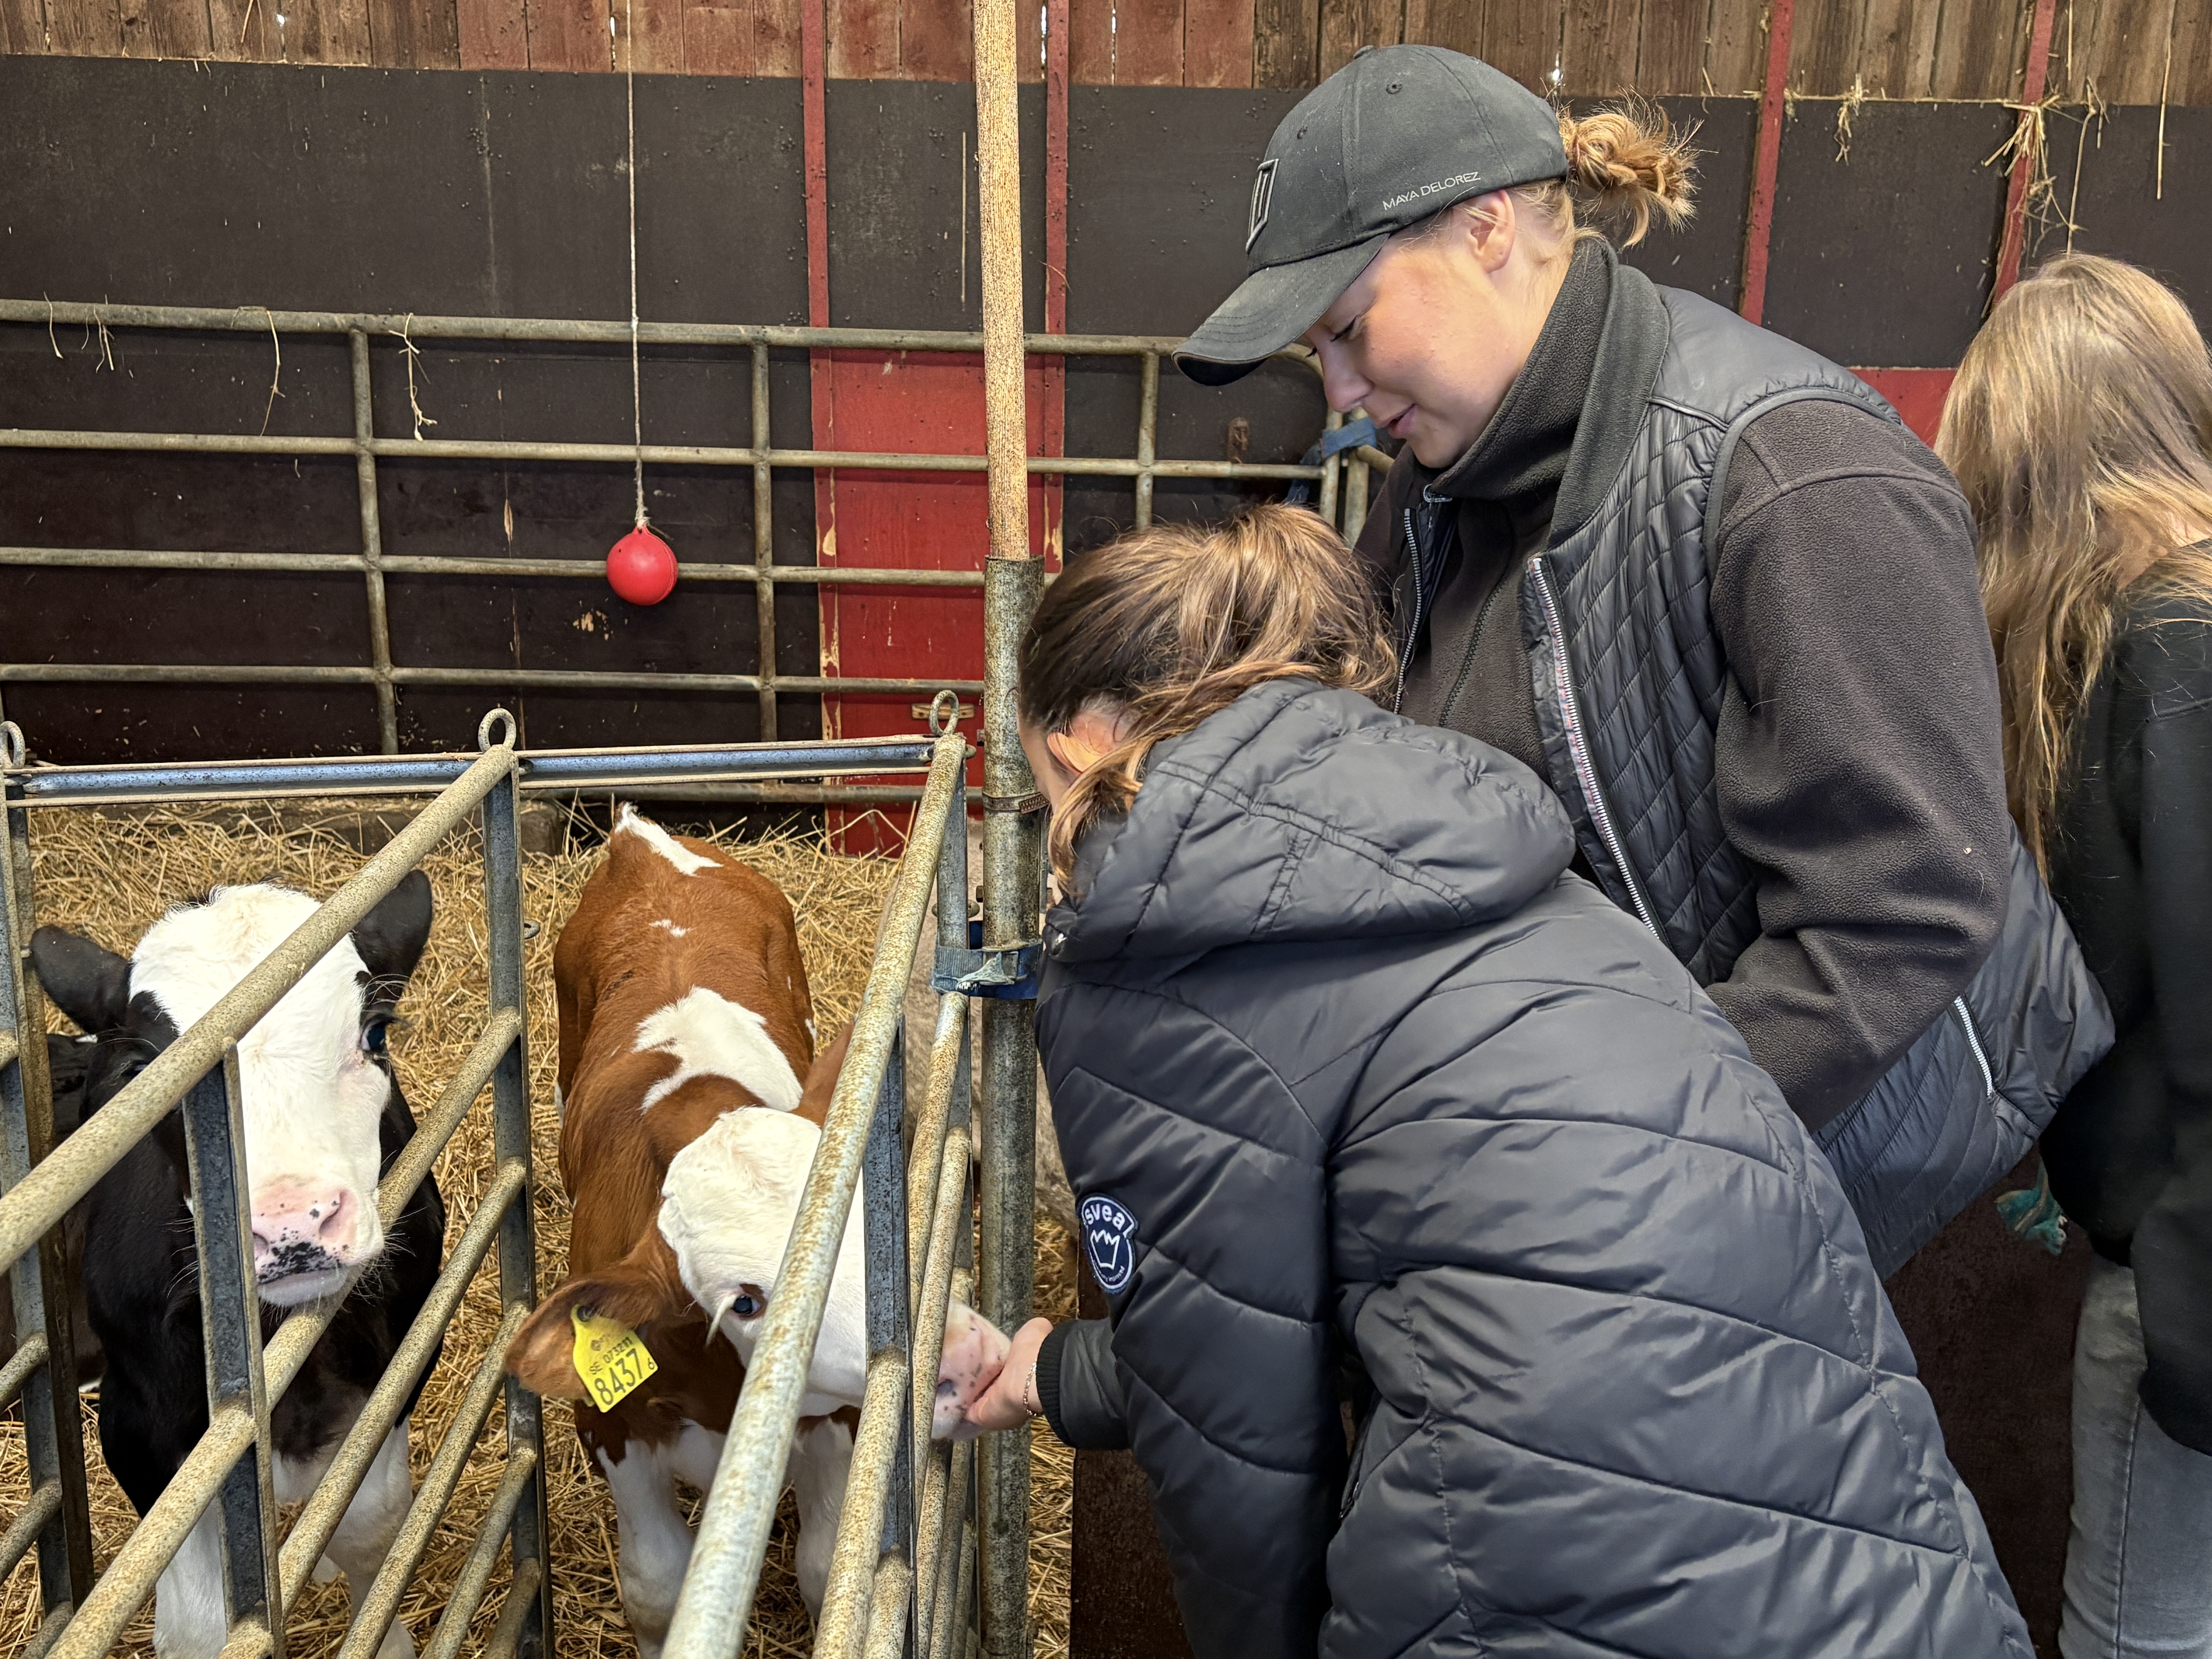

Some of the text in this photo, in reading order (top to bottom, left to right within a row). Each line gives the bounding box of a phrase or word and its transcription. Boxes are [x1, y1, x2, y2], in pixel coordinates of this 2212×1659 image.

[1382, 172, 1481, 210] MAYA DELOREZ
[1084, 1203, 1125, 1231] svea
[589, 1362, 603, 1375] SE
[594, 1348, 655, 1405] 8437 6
